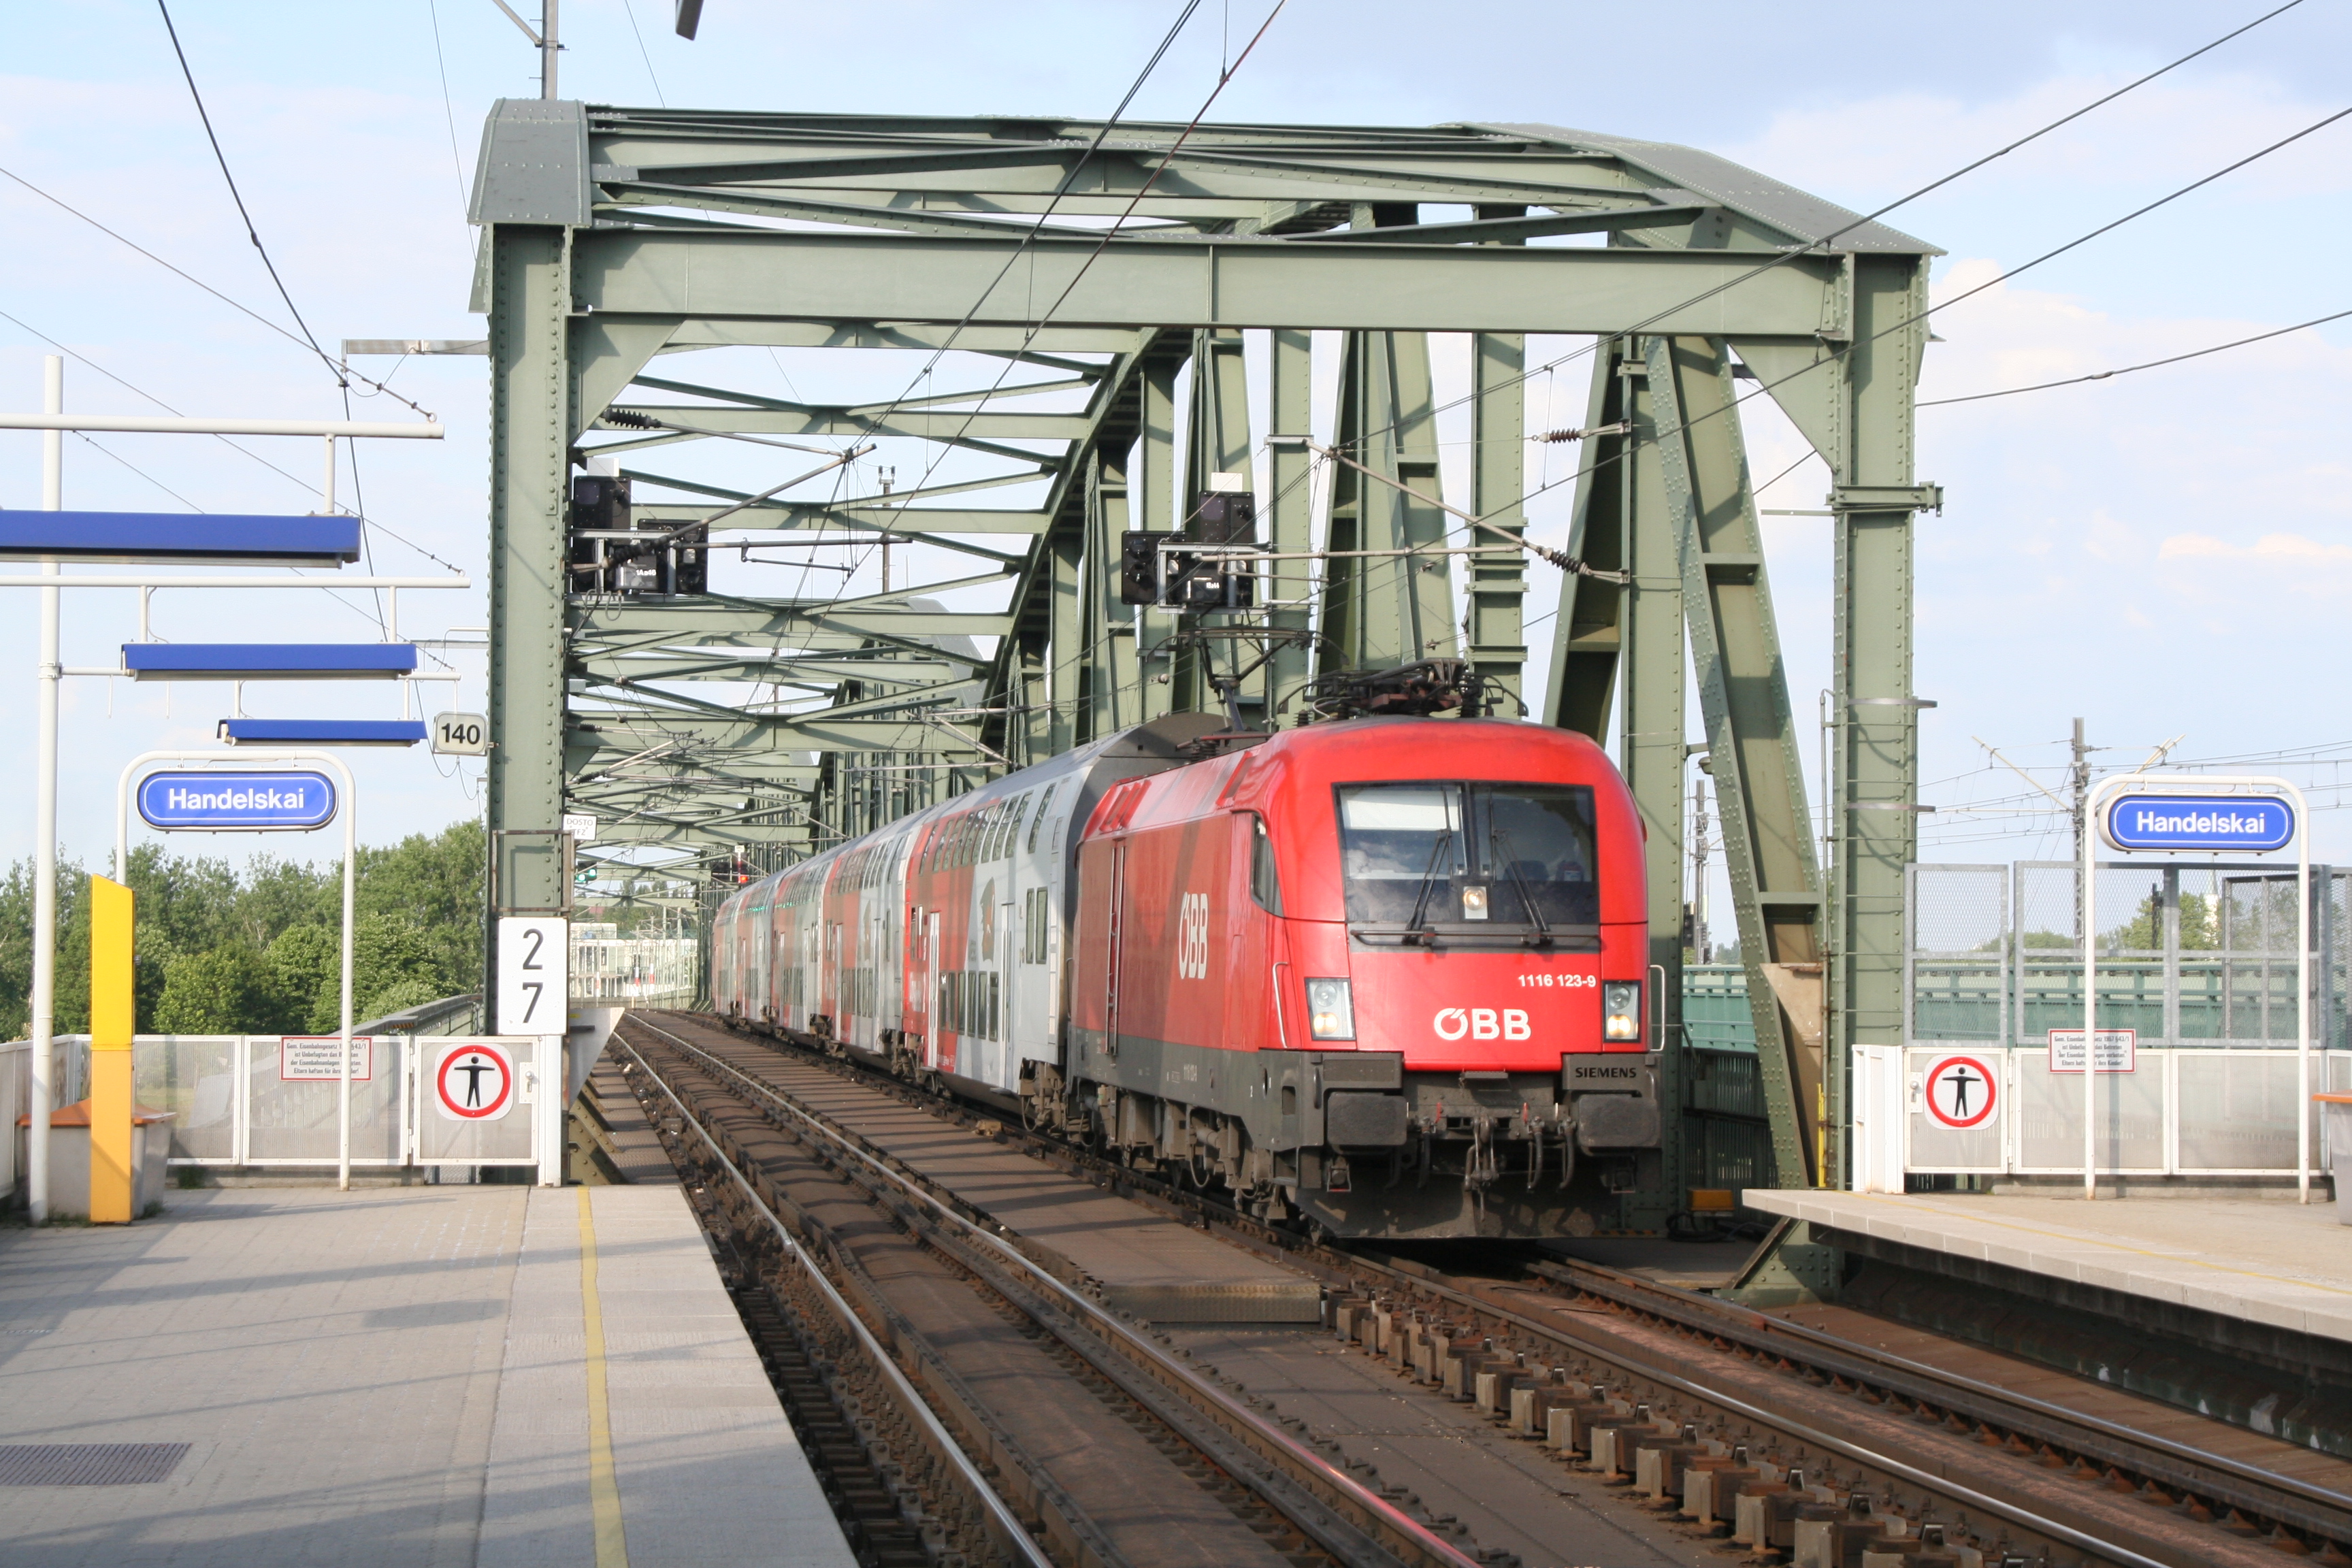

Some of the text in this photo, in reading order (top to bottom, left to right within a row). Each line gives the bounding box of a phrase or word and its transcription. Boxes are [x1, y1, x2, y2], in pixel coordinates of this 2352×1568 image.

[441, 723, 480, 745] 140
[169, 788, 304, 809] Handelskai
[567, 818, 593, 826] DOSTO
[2137, 811, 2265, 833] Handelskai
[1179, 892, 1208, 979] ÖBB
[523, 928, 544, 970] 2
[1518, 975, 1597, 987] 1116 123-9
[523, 982, 543, 1024] 7
[1434, 1008, 1532, 1041] ÖBB
[1575, 1067, 1637, 1078] SIEMENS
